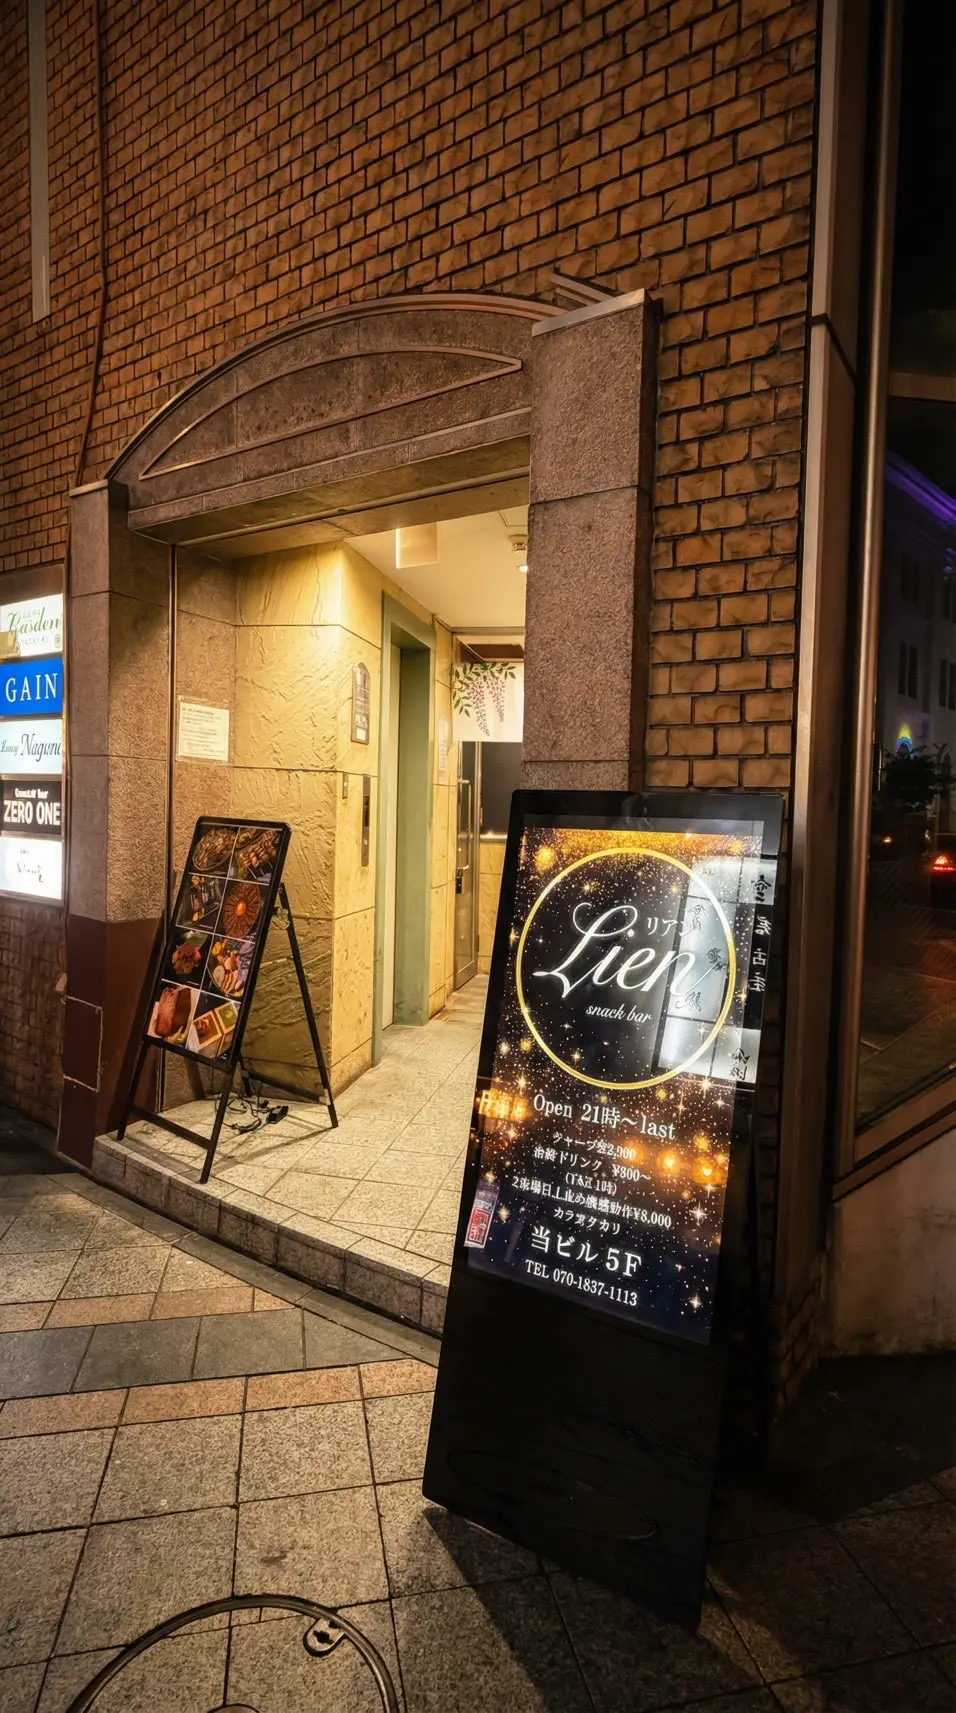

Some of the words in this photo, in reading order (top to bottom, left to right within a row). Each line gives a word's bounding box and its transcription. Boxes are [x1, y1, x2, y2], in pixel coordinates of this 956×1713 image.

[5, 673, 58, 703] GAIN
[3, 799, 34, 825] ZERO
[35, 801, 61, 826] ONE
[647, 916, 694, 938] リアン
[533, 902, 719, 999] Lien
[585, 1003, 626, 1020] snack
[626, 1004, 652, 1024] bar
[533, 1094, 573, 1118] Open
[525, 1259, 550, 1279] TEL
[552, 1268, 638, 1307] 070-1837-1113
